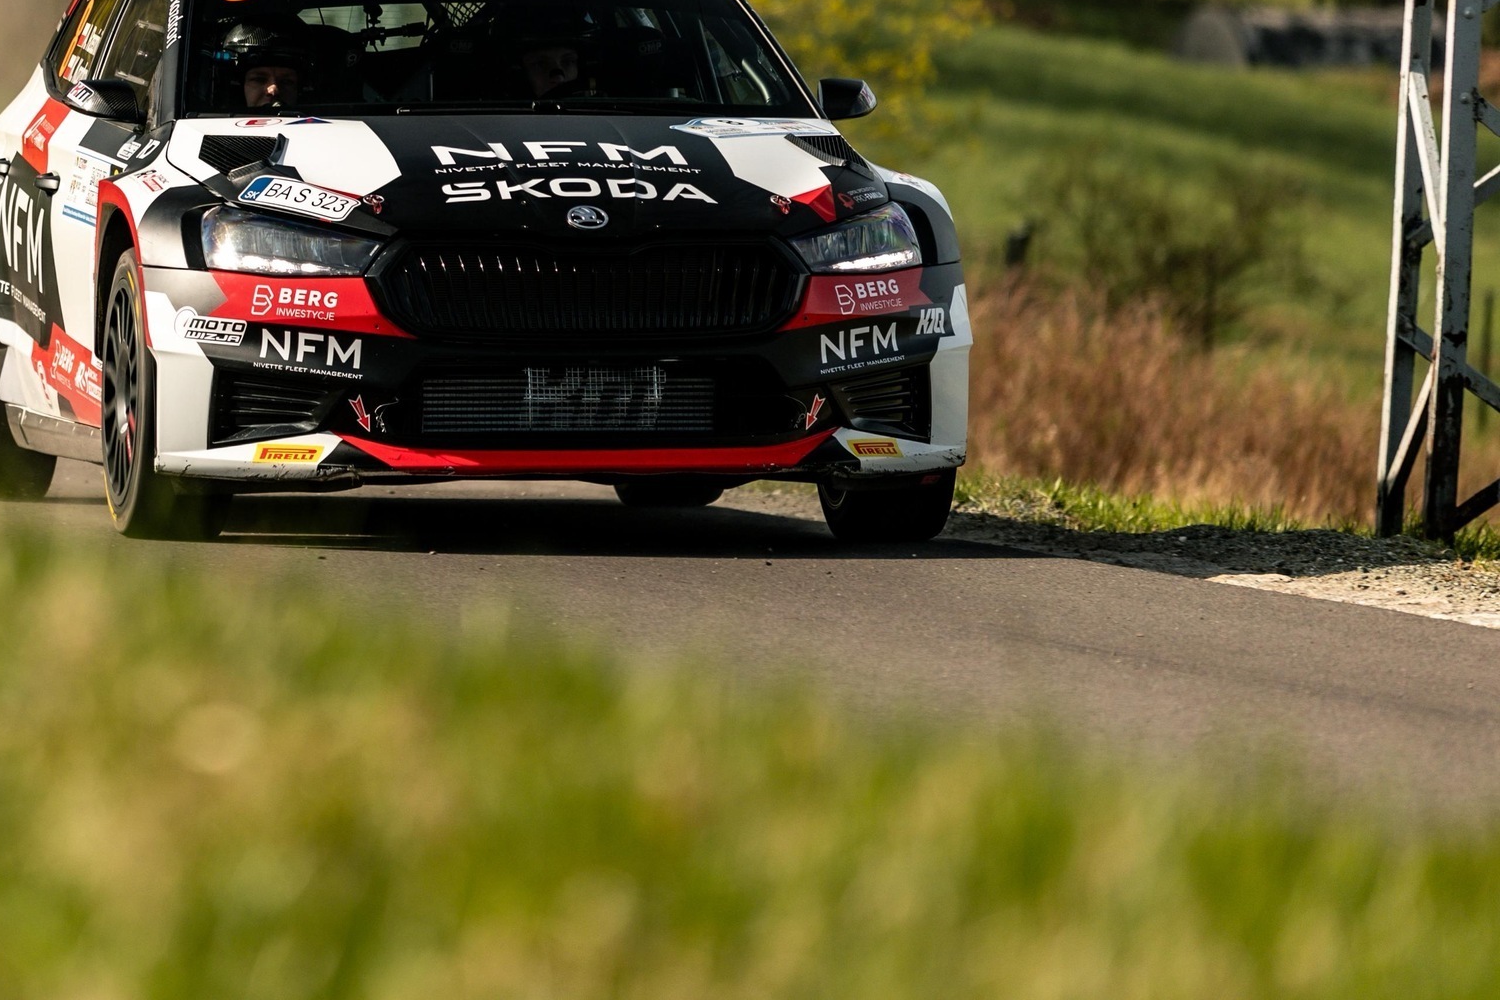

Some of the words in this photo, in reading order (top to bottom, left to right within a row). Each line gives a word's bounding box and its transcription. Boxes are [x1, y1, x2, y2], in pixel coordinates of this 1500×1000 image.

[430, 141, 688, 165] NFM
[434, 162, 508, 174] NIVETTE
[516, 161, 569, 169] FLEET
[577, 162, 702, 174] MANAGEMENT
[244, 190, 260, 200] SK
[264, 182, 293, 200] BA
[294, 188, 311, 204] S
[311, 192, 349, 213] 323
[441, 178, 719, 204] SKODA
[278, 287, 338, 308] BERG
[854, 279, 900, 299] BERG
[276, 307, 335, 321] INWESTYCJE
[860, 298, 903, 312] INWESTYCJE
[189, 318, 246, 333] MOTO
[185, 330, 241, 343] WIZJA
[820, 322, 899, 364] NFM
[259, 328, 362, 370] NFM
[253, 361, 283, 371] NIVETTE
[285, 364, 308, 373] FLEET
[310, 368, 364, 380] MANAGEMENT
[820, 362, 846, 375] NIVETTE
[847, 361, 866, 370] FLEET
[866, 354, 906, 367] MANAGEMENT
[260, 447, 317, 460] PIRELLI
[853, 442, 898, 455] PIRELLI
